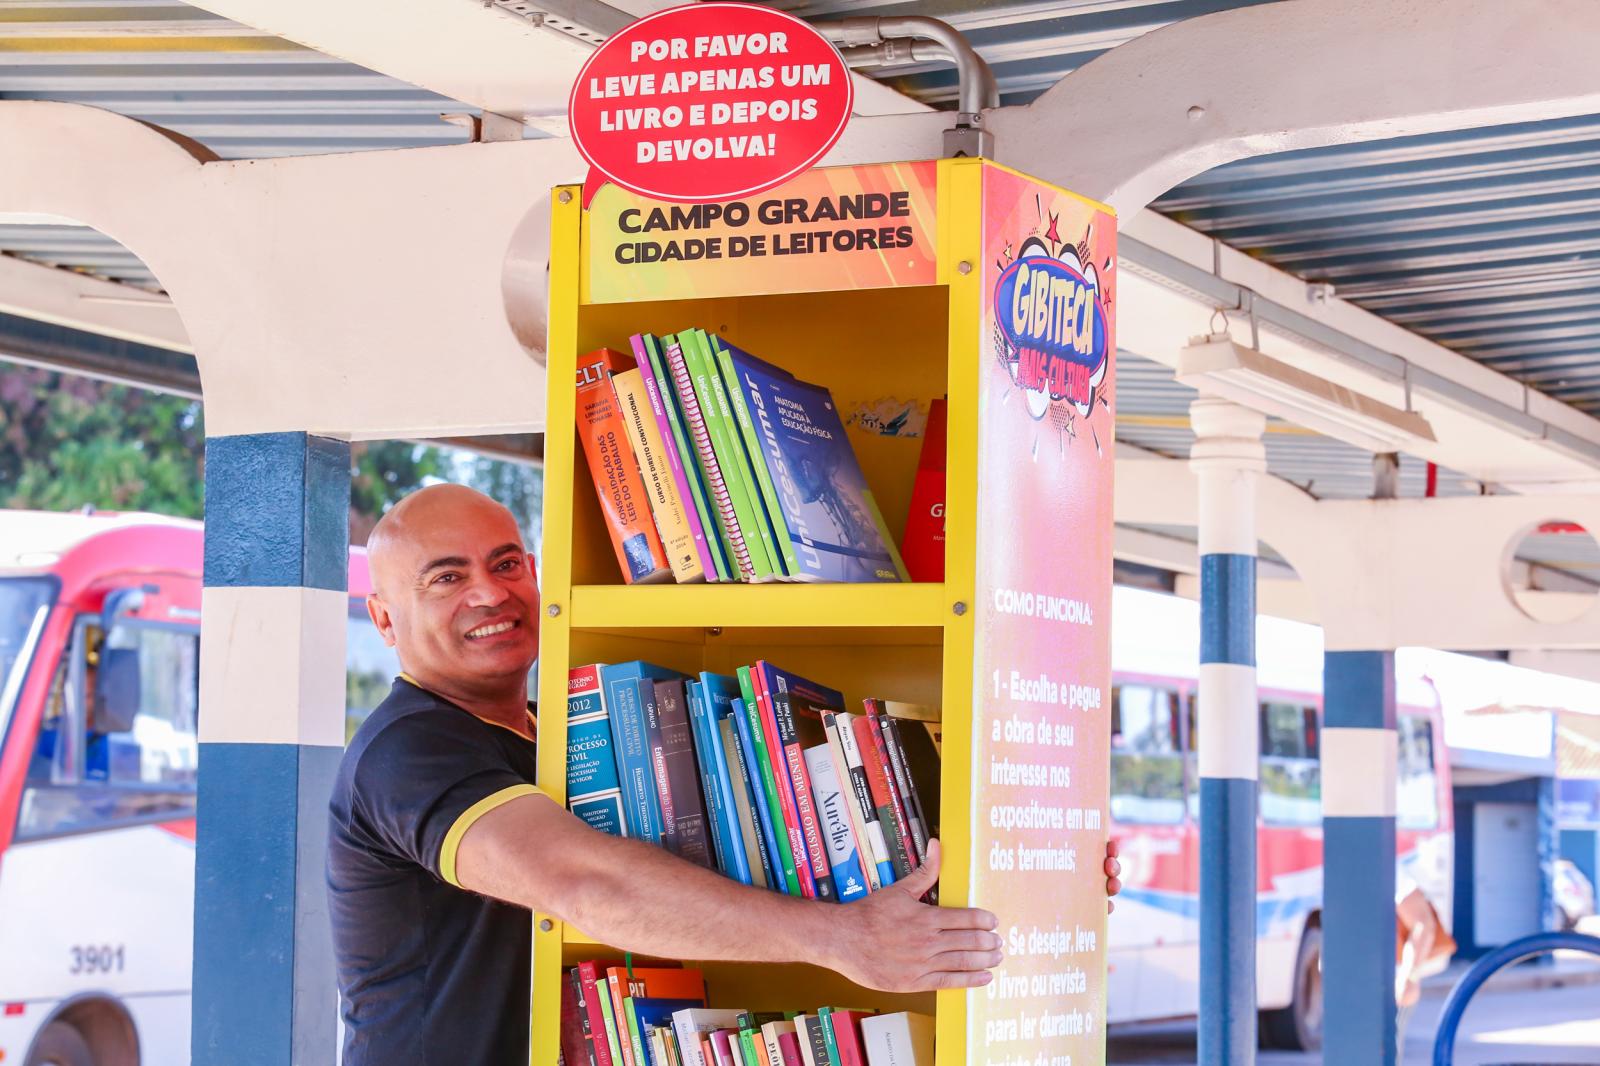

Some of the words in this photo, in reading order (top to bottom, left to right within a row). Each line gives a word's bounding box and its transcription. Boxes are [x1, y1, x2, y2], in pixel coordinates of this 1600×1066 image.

[630, 39, 689, 63] POR
[694, 32, 788, 58] FAVOR
[590, 72, 655, 99] LEVE
[660, 67, 775, 95] APENAS
[780, 64, 830, 86] UM
[600, 108, 683, 132] LIVRO
[689, 105, 706, 126] E
[711, 99, 818, 125] DEPOIS
[636, 134, 777, 163] DEVOLVA!
[618, 201, 750, 234] CAMPO
[757, 191, 910, 223] GRANDE
[614, 239, 722, 265] CIDADE
[728, 236, 768, 257] DE
[772, 226, 913, 254] LEITORES
[1012, 262, 1096, 356] GIBITECA
[1049, 353, 1090, 406] CULTURA
[627, 392, 648, 445] CONSTITUCIONAL
[774, 395, 805, 412] ANATOMIA
[779, 407, 805, 422] APLICADA
[596, 434, 608, 453] DAS
[781, 417, 814, 435] EDUCAÇÃO
[813, 426, 833, 440] FÍSICA
[606, 430, 627, 482] TRABALHO
[643, 446, 656, 471] DIREITO
[602, 454, 629, 525] CONSOLIDAÇÃO
[621, 484, 631, 500] DO
[651, 472, 658, 481] DE
[654, 481, 665, 503] CURSO
[626, 501, 637, 521] LEIS
[930, 503, 946, 518] G
[994, 588, 1034, 617] COMO
[568, 698, 592, 713] 2012
[992, 669, 1000, 699] 1
[1010, 670, 1058, 705] Escolha
[1061, 686, 1068, 705] e
[1069, 685, 1101, 712] pegue
[646, 703, 657, 729] CARVALHO
[748, 702, 761, 743] UniCesumar
[774, 700, 783, 716] Levine
[778, 721, 789, 740] Michael
[992, 723, 1000, 742] a
[1004, 714, 1034, 744] obra
[1037, 716, 1053, 746] de
[1055, 725, 1074, 746] seu
[652, 746, 670, 794] Enfermagem
[788, 748, 802, 789] MENTE
[886, 740, 903, 785] Desglobalização
[991, 755, 1047, 787] interesse
[1050, 766, 1071, 788] nos
[633, 767, 646, 799] HUMBERTO
[662, 795, 669, 804] do
[799, 794, 810, 813] EM
[639, 801, 651, 832] THEODORO
[663, 806, 676, 834] Trabalho
[822, 790, 849, 851] Aurélio
[990, 800, 1063, 832] expositores
[1066, 812, 1083, 830] em
[1085, 809, 1101, 831] um
[803, 817, 824, 873] RACISMO
[894, 826, 905, 850] Franco
[990, 841, 1014, 872] dos
[1008, 926, 1025, 956] Se
[1028, 925, 1074, 960] desejar,
[1075, 925, 1096, 952] leve
[69, 943, 125, 976] 3901
[986, 980, 995, 999] o
[1000, 970, 1029, 999] livro
[1031, 974, 1046, 996] ou
[1050, 966, 1086, 995] revista
[986, 1016, 1017, 1047] para
[1020, 1011, 1037, 1040] ler
[1040, 1008, 1083, 1037] durante
[1086, 1012, 1093, 1033] o
